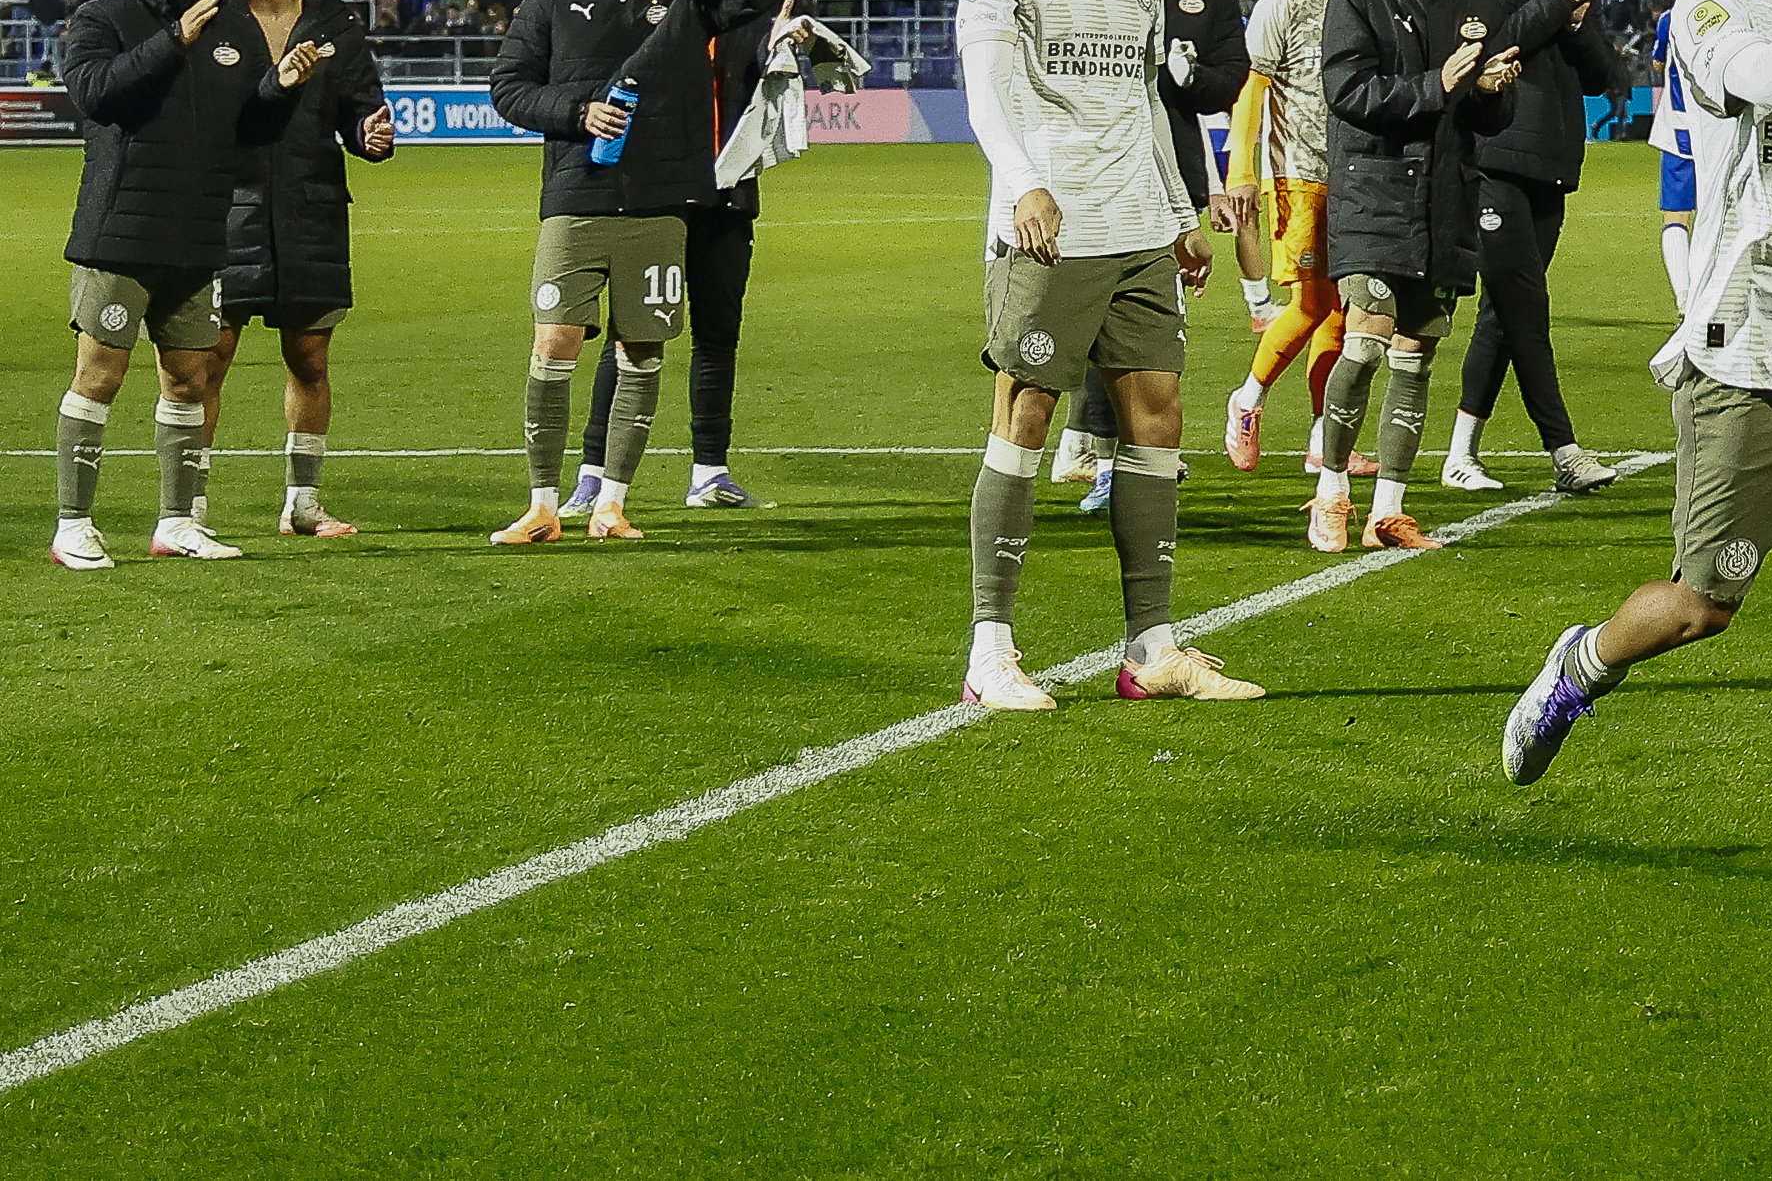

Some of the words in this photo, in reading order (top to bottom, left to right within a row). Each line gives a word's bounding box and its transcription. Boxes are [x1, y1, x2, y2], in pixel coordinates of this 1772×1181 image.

[1047, 42, 1146, 60] BRAINPOR
[1046, 60, 1144, 79] EINDHOVE
[806, 101, 862, 131] ARK
[643, 265, 683, 305] 10
[994, 536, 1029, 546] PSV
[1157, 540, 1177, 550] PS
